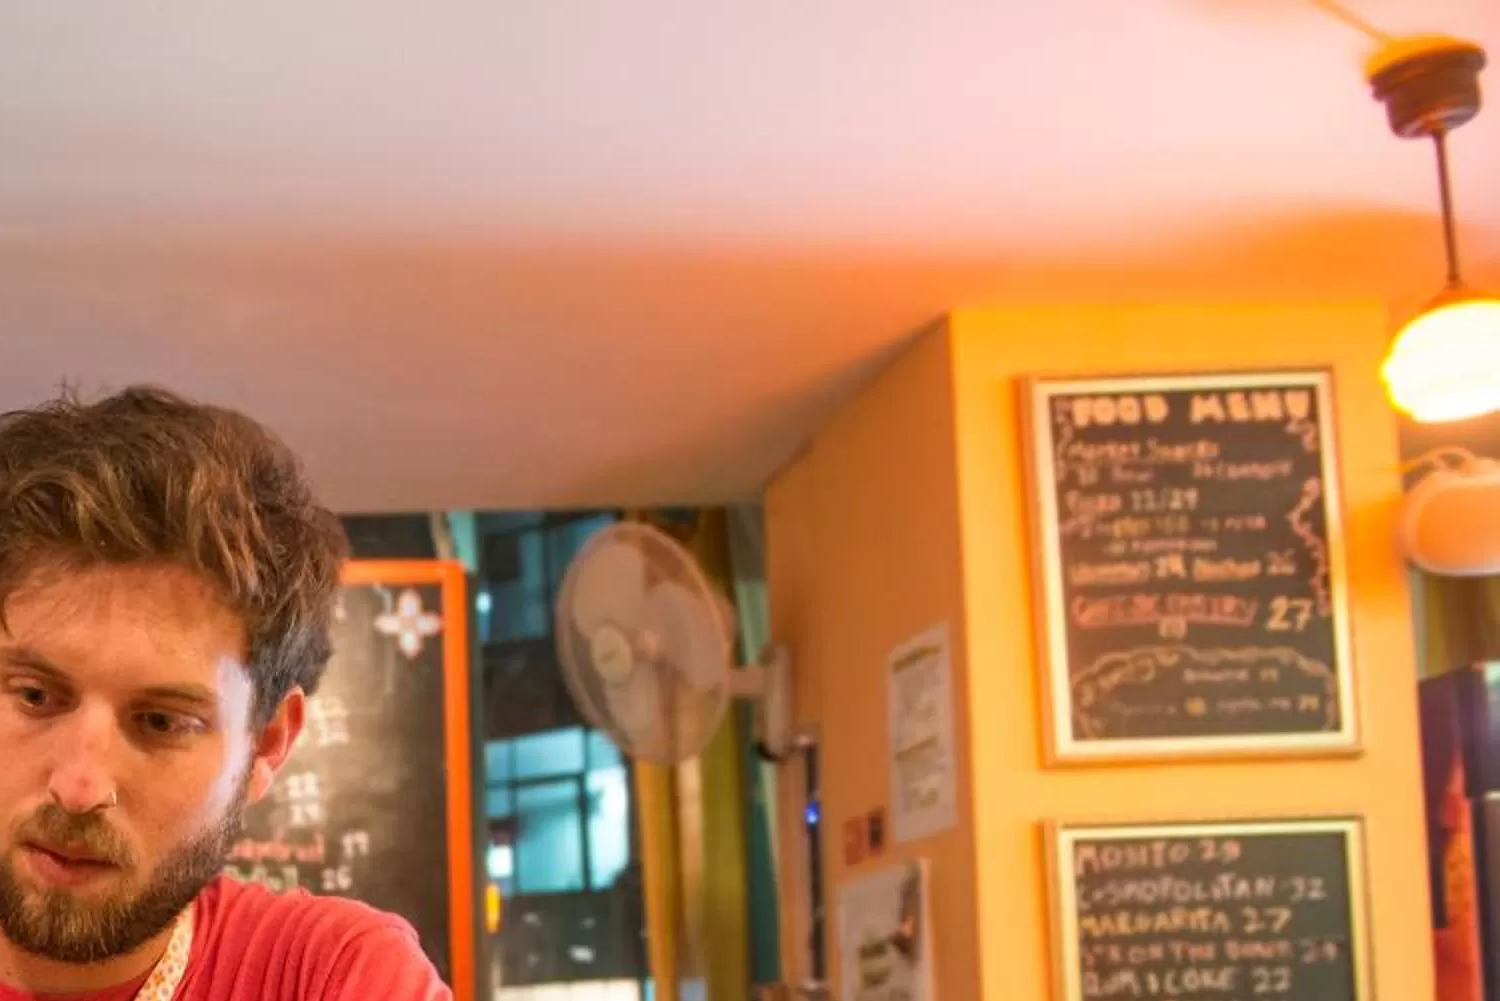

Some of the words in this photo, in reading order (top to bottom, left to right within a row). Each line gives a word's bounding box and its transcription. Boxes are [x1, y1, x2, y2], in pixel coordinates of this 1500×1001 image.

[1071, 394, 1169, 427] FOOD
[1190, 390, 1309, 424] MENU
[1266, 596, 1313, 631] 27
[1241, 906, 1293, 934] 27
[1165, 966, 1236, 994] COKE
